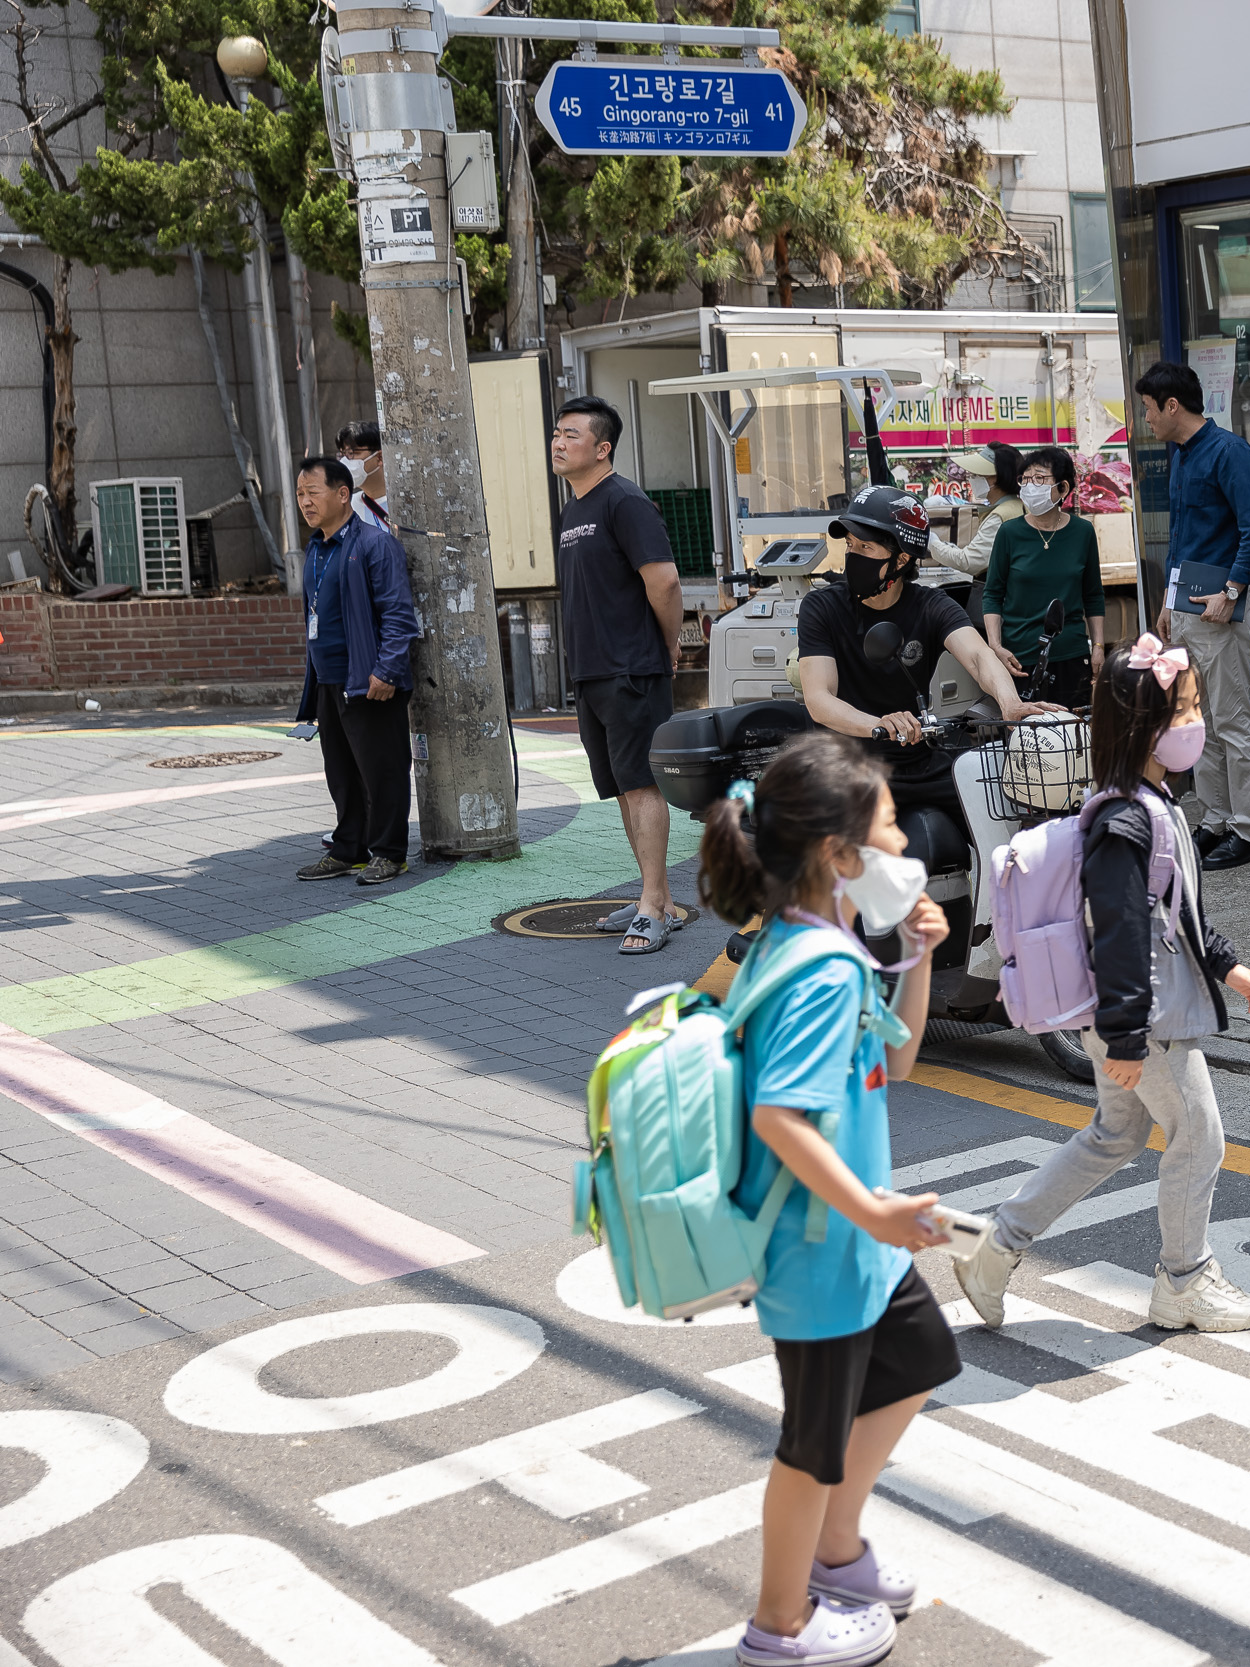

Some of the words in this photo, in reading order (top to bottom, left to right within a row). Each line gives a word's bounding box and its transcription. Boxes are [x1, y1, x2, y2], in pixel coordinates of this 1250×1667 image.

[609, 74, 735, 105] 긴고랑로7길
[559, 97, 582, 118] 45
[603, 105, 709, 127] Gingorang-ro
[714, 107, 749, 128] 7-gil
[765, 102, 783, 122] 41
[402, 210, 423, 229] PT
[942, 397, 995, 422] HOME
[999, 395, 1030, 421] 마트
